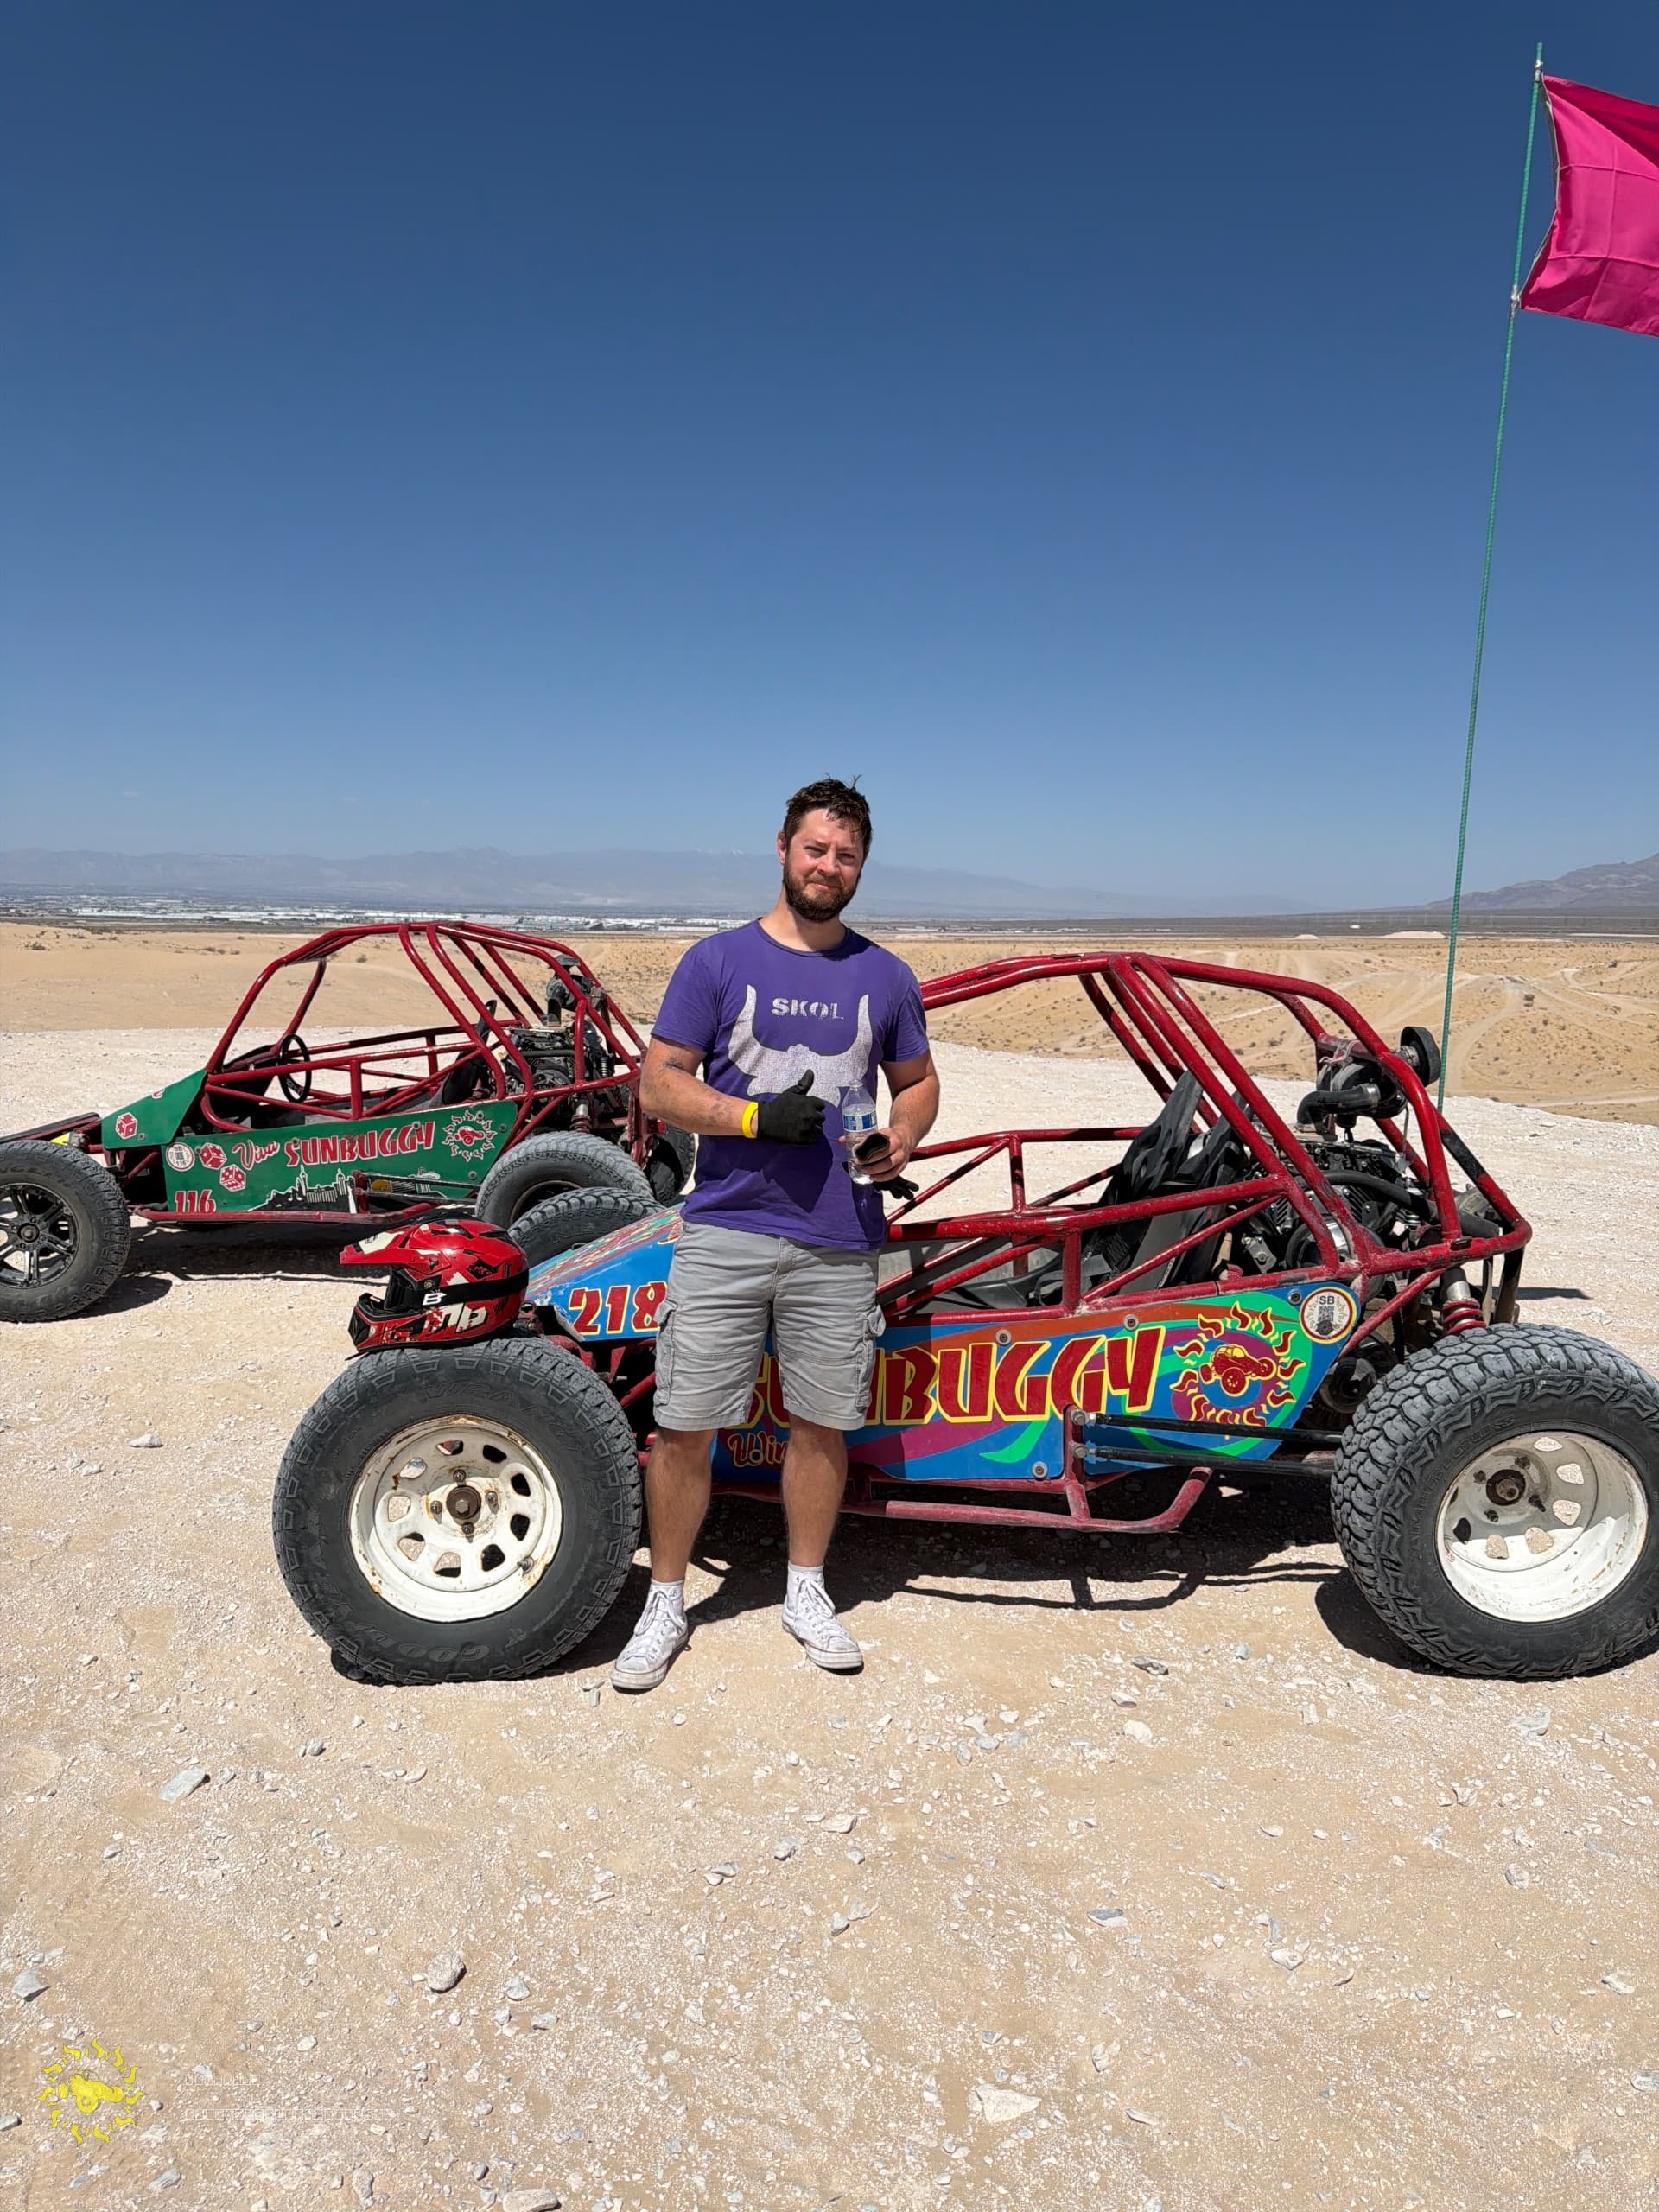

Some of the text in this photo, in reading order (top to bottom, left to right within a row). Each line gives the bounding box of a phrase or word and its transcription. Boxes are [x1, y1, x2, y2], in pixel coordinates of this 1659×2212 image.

[771, 998, 844, 1019] SKOL
[232, 1122, 435, 1170] Viva SUNBUGGY
[175, 1189, 216, 1213] 116
[569, 1281, 667, 1334] 218
[1319, 1295, 1335, 1306] SB
